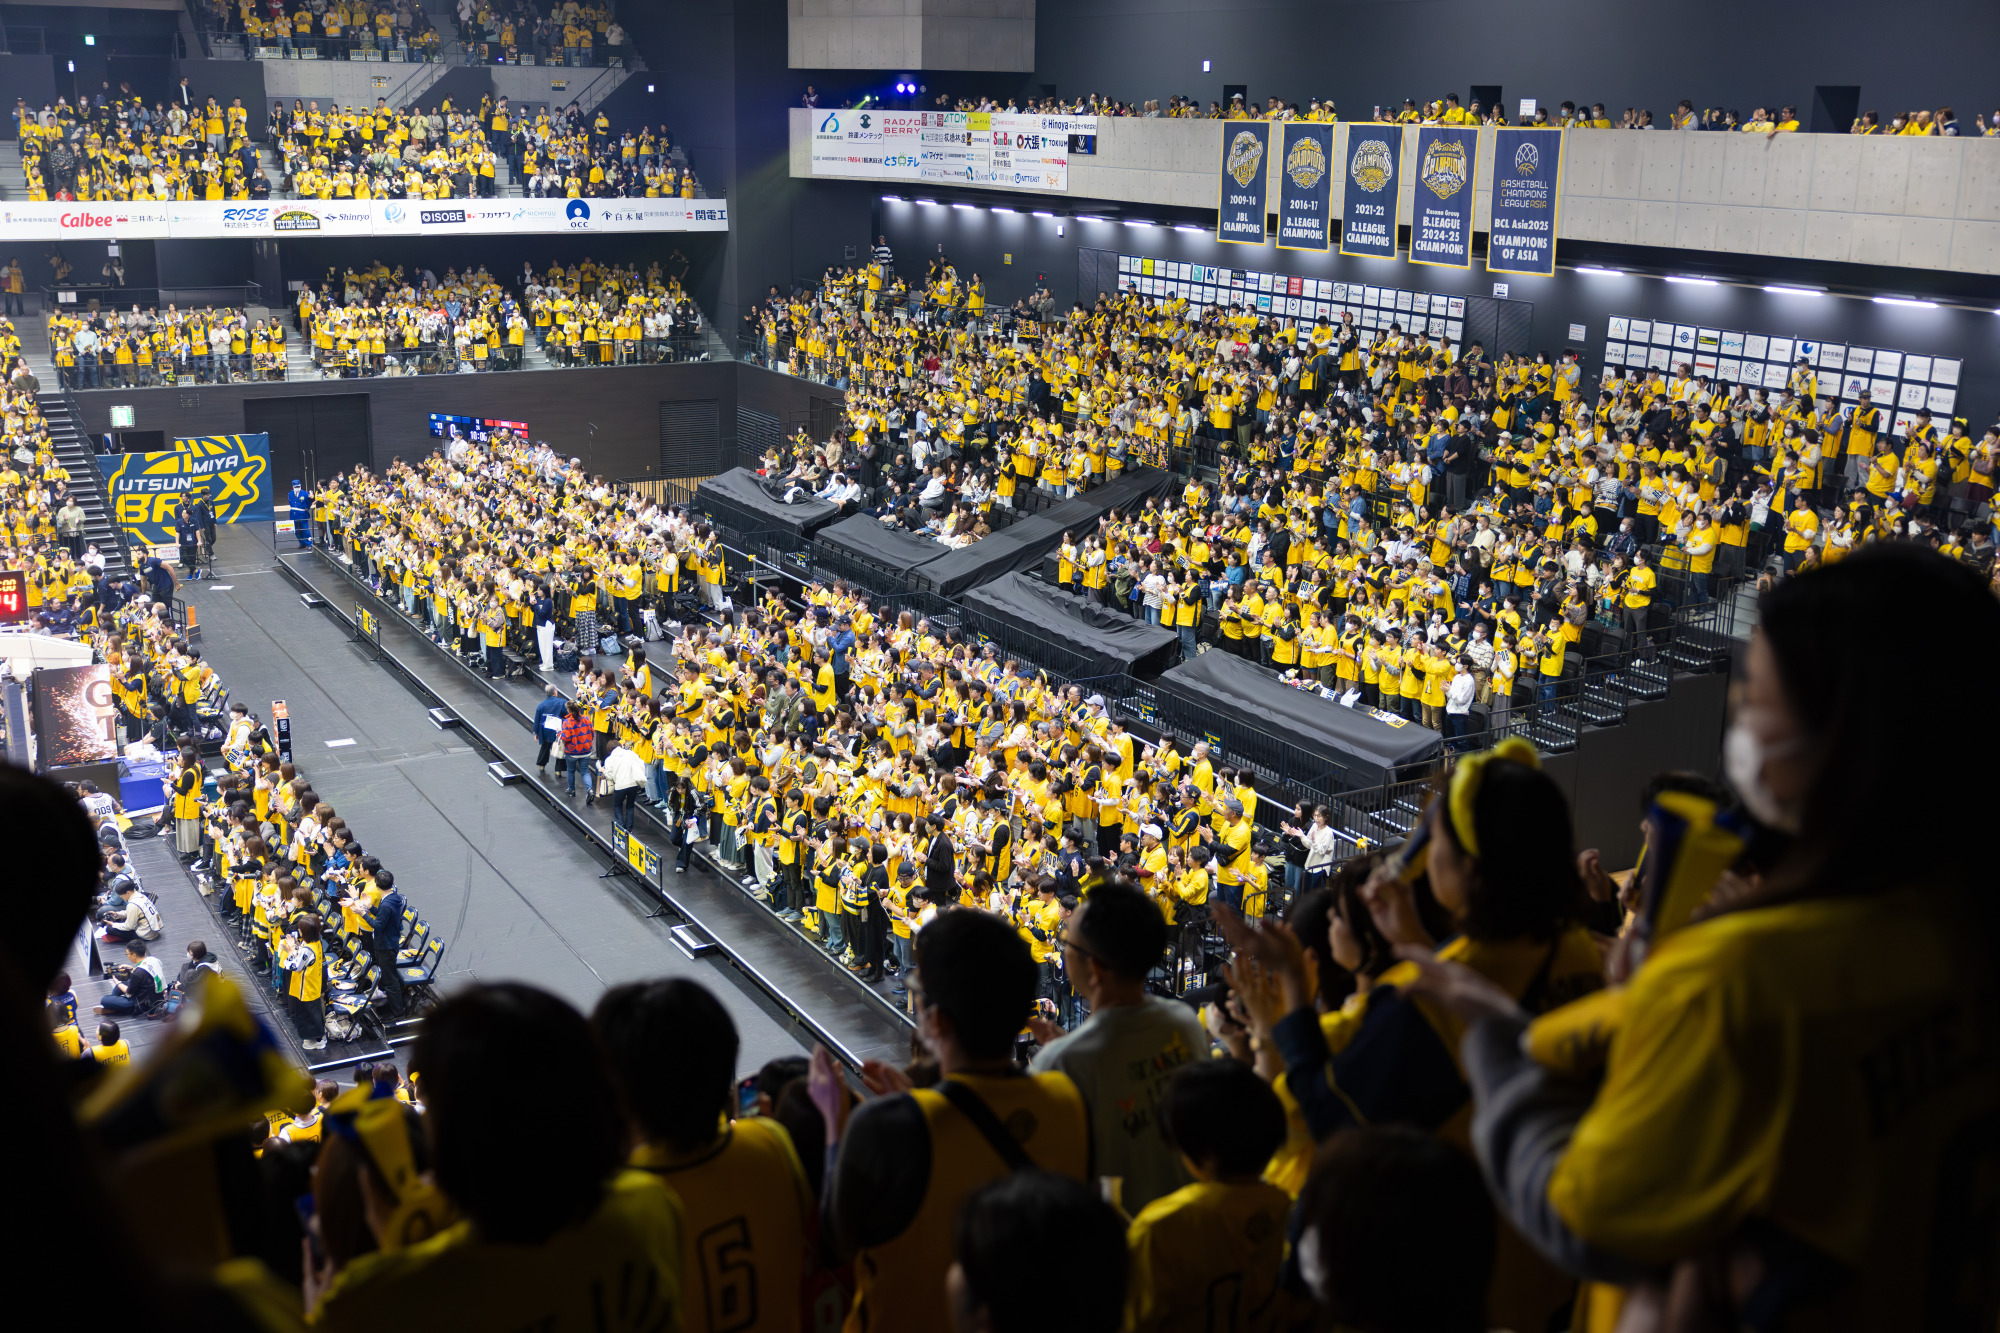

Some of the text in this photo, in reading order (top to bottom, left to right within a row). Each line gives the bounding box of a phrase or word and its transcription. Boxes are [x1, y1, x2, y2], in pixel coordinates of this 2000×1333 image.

[1048, 119, 1068, 131] Hinoya
[1024, 135, 1039, 150] 大張
[1501, 180, 1548, 189] BASKETBALL
[1502, 189, 1547, 198] CHAMPIONS
[1230, 195, 1256, 205] 2009-10
[1290, 200, 1318, 210] 2016-17
[223, 208, 269, 221] RISE
[695, 210, 727, 220] 関電工
[1356, 204, 1384, 216] 2021-22
[1444, 209, 1459, 218] Group
[60, 213, 112, 228] Calbee
[339, 213, 370, 222] Shinryo
[432, 212, 463, 222] ISOBE
[616, 213, 643, 221] 白木屋
[1236, 212, 1248, 222] JBL
[1224, 223, 1260, 233] CHAMPIONS
[1495, 219, 1509, 228] BCL
[1283, 228, 1323, 240] CHAMPIONS
[1347, 233, 1389, 246] CHAMPIONS
[1422, 229, 1459, 242] 2024-25
[1416, 241, 1463, 254] CHAMPIONS
[1493, 235, 1547, 248] CHAMPIONS
[1502, 249, 1538, 261] OF ASIA
[193, 455, 238, 474] MIYA
[119, 477, 193, 491] UTSUN
[700, 1215, 757, 1333] 6
